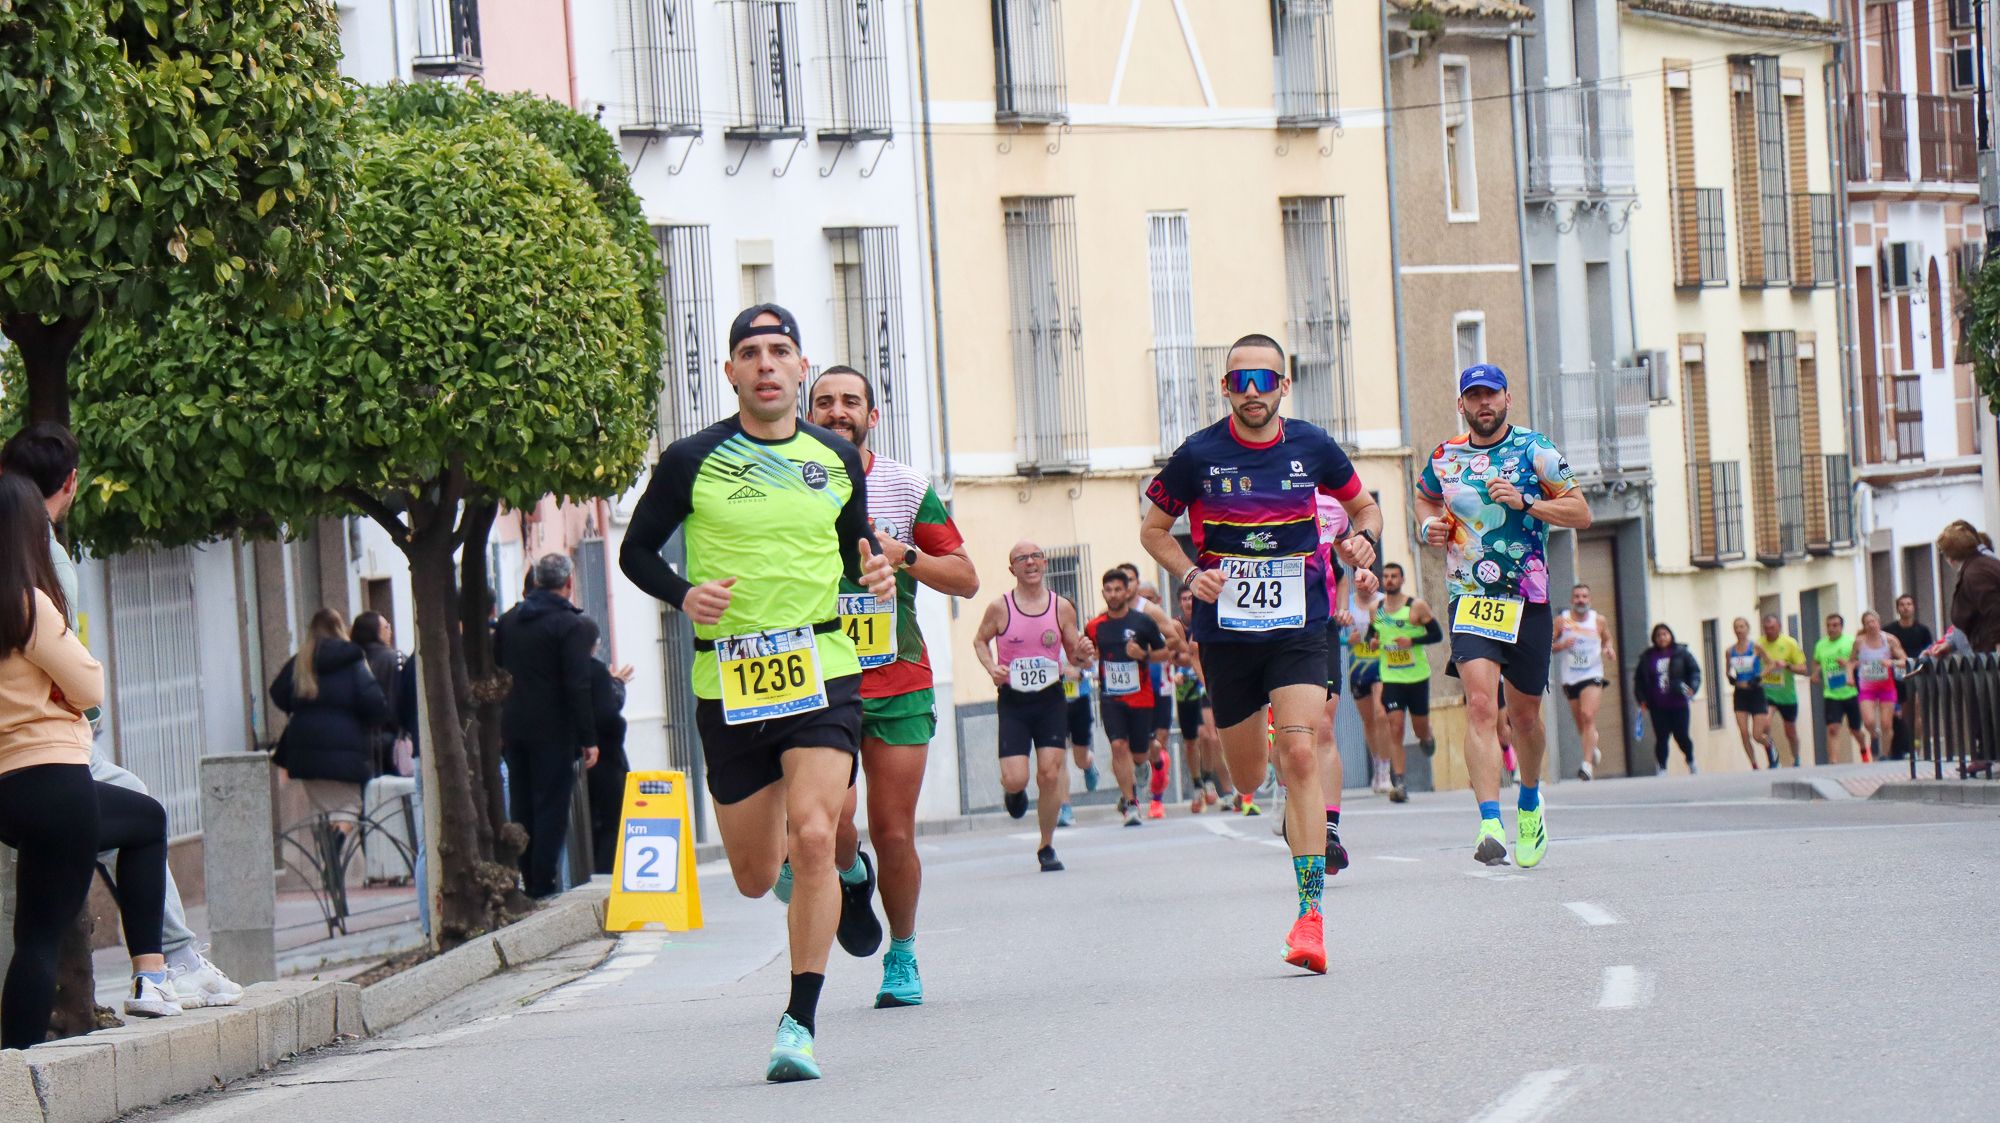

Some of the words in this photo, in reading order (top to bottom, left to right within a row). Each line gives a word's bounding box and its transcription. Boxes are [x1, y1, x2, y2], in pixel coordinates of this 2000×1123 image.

[1237, 581, 1281, 608] 243
[1469, 600, 1505, 622] 435
[733, 654, 805, 695] 1236
[1021, 669, 1047, 686] 926
[1111, 672, 1131, 684] 943
[627, 824, 648, 834] km
[636, 847, 660, 877] 2
